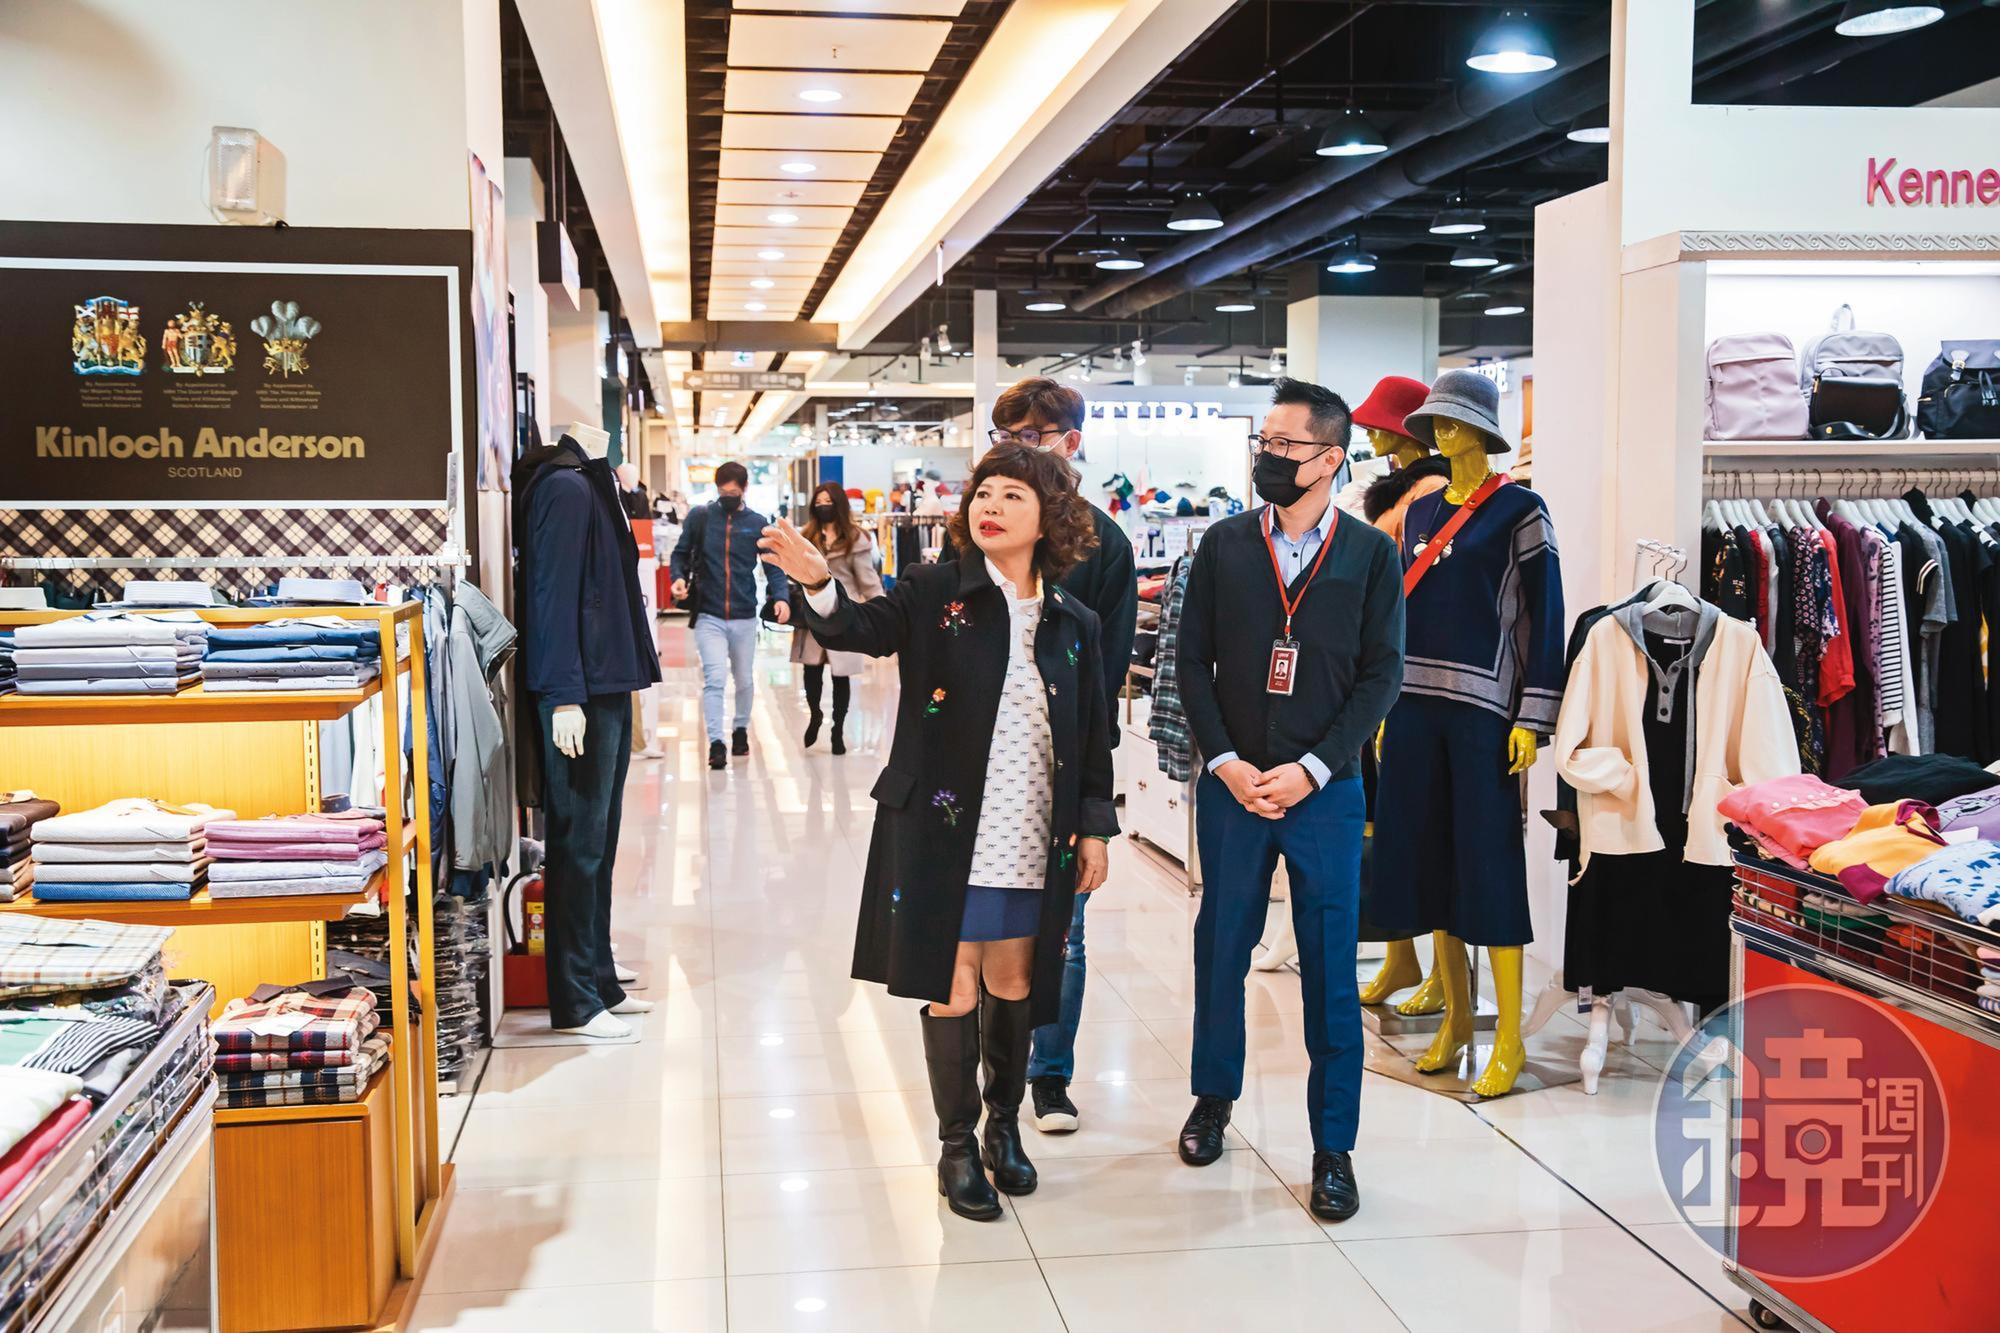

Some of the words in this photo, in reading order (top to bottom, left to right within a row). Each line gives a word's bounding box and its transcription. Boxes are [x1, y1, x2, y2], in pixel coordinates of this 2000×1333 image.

[1867, 158, 2000, 206] Kenne
[1084, 401, 1222, 437] TURE
[36, 426, 184, 459] Kinloch
[192, 426, 366, 460] Anderson
[167, 466, 243, 479] SCOTLAND
